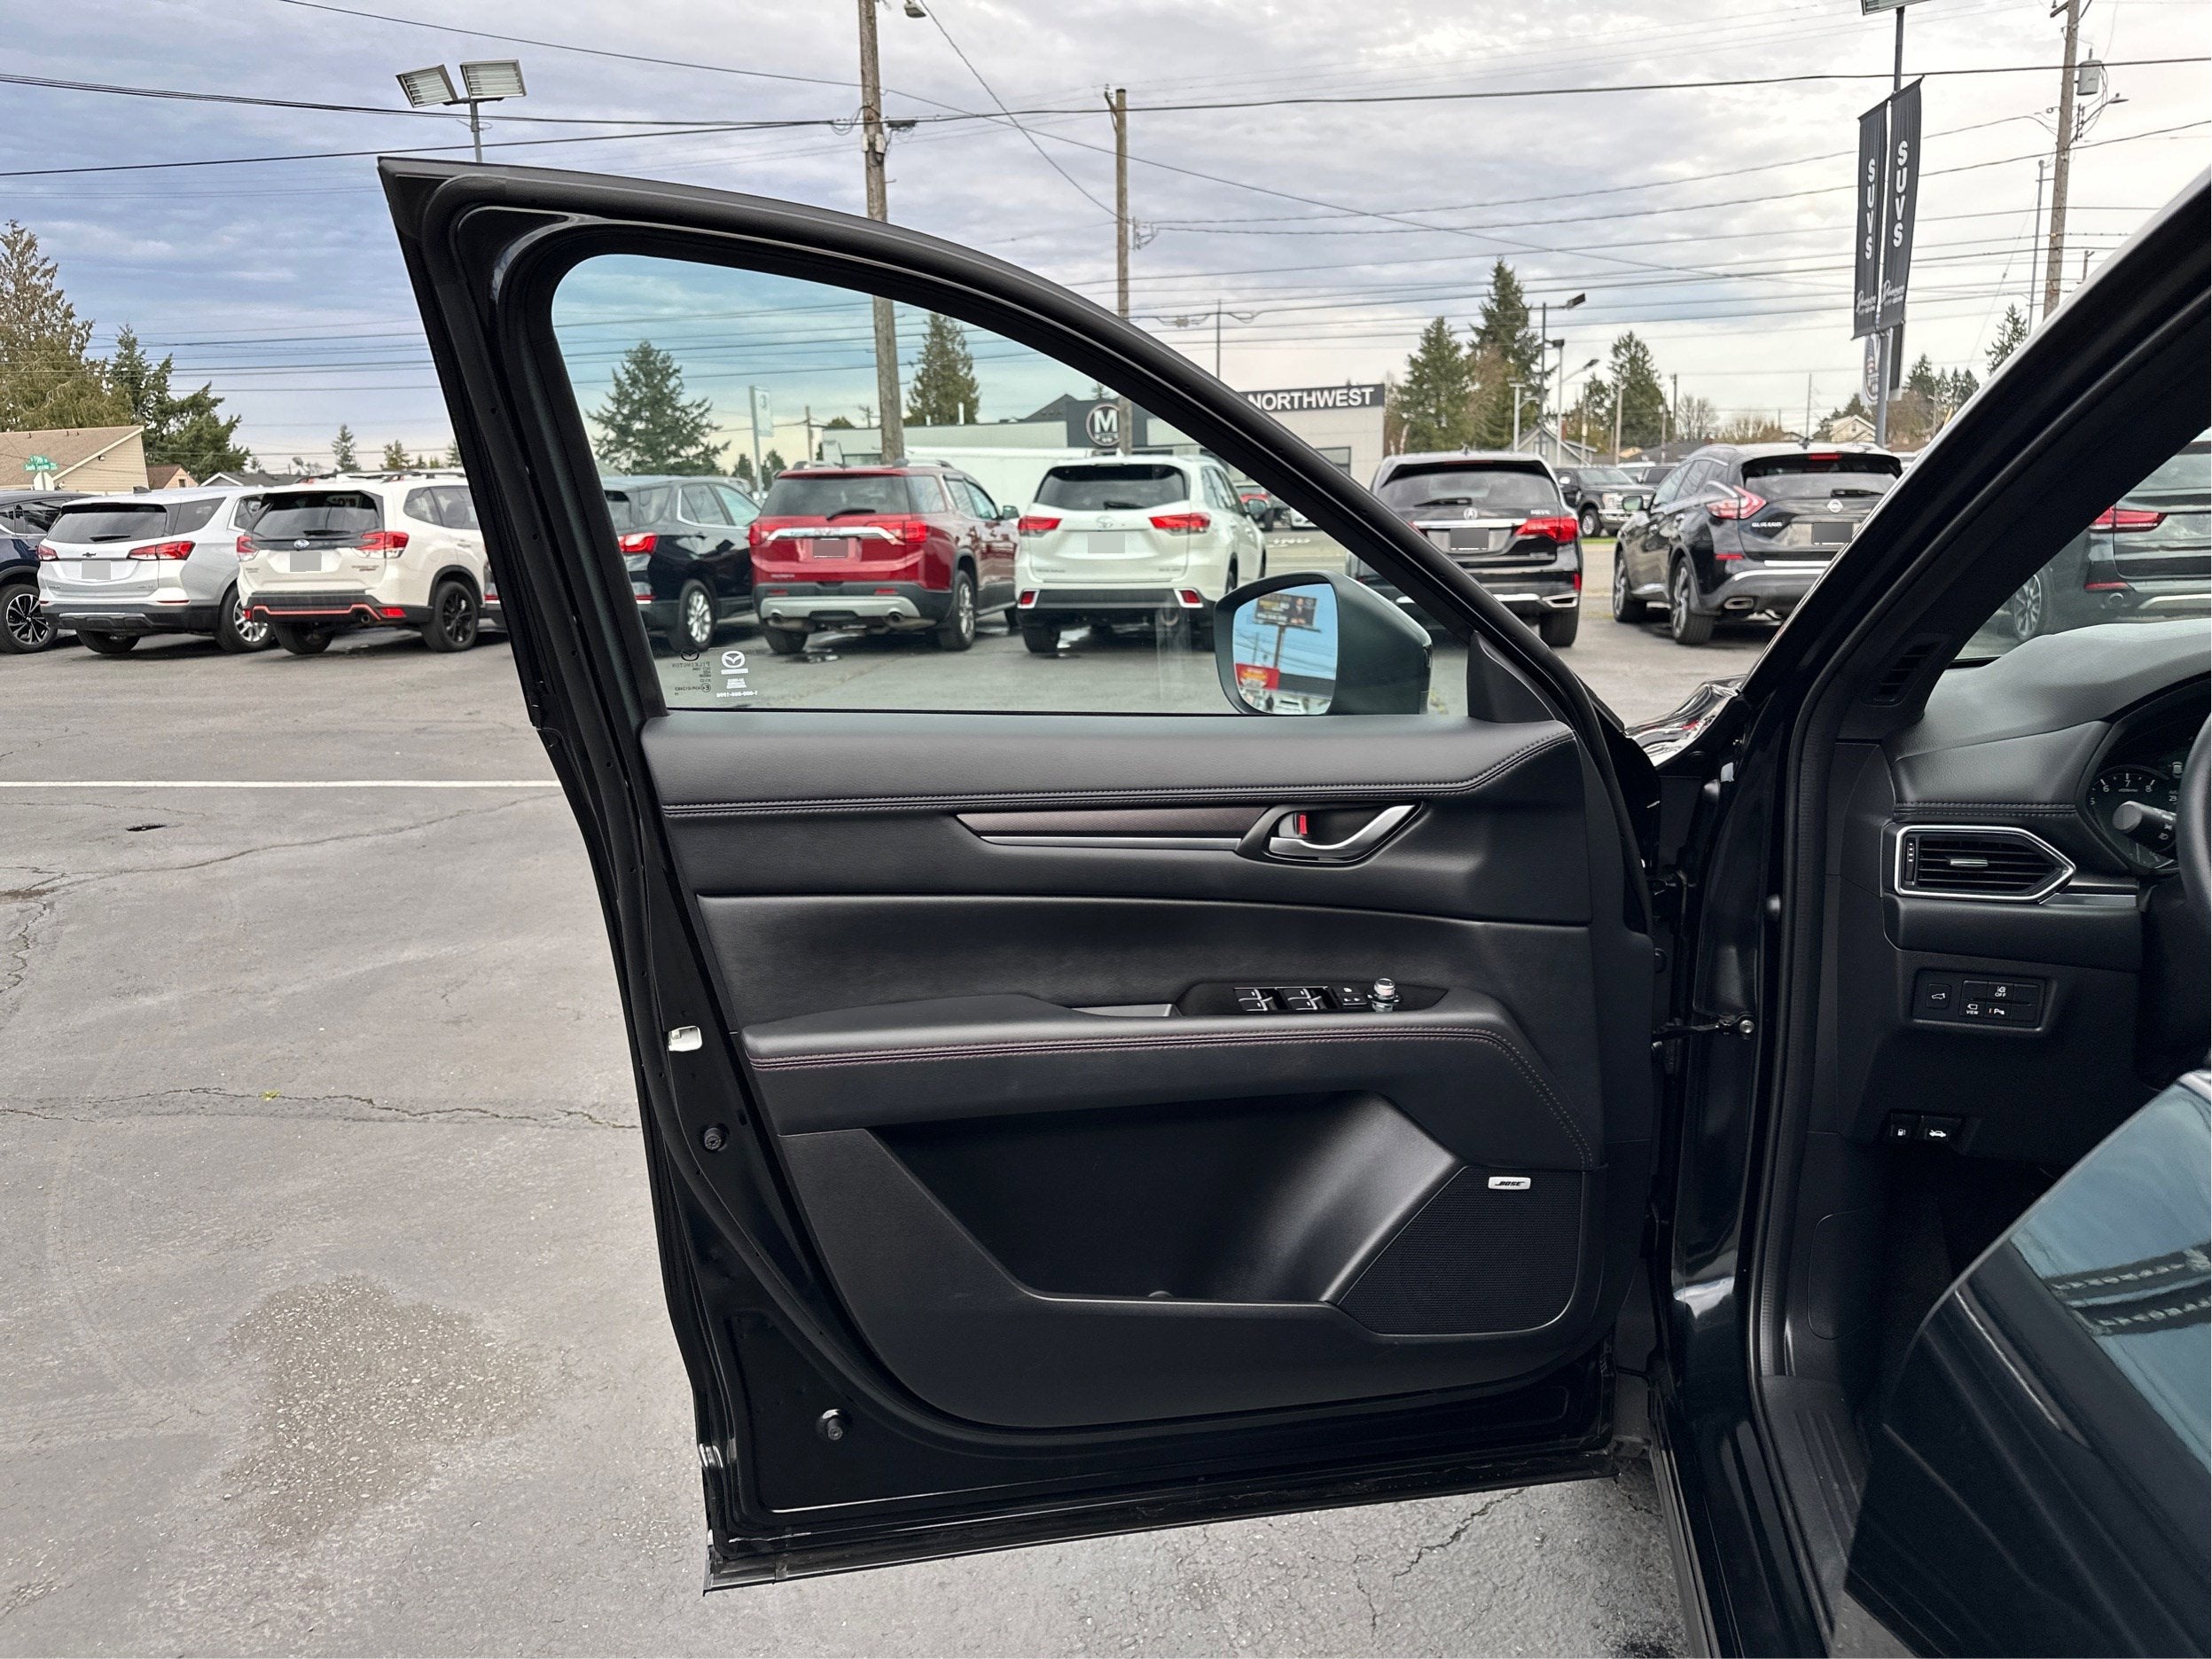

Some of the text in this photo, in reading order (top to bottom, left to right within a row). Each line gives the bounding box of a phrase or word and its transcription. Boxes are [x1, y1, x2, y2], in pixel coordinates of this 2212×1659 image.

[1864, 158, 1876, 260] SUVS
[1893, 140, 1909, 247] SUVS
[1094, 410, 1118, 434] M
[1248, 387, 1374, 411] NORTHWEST
